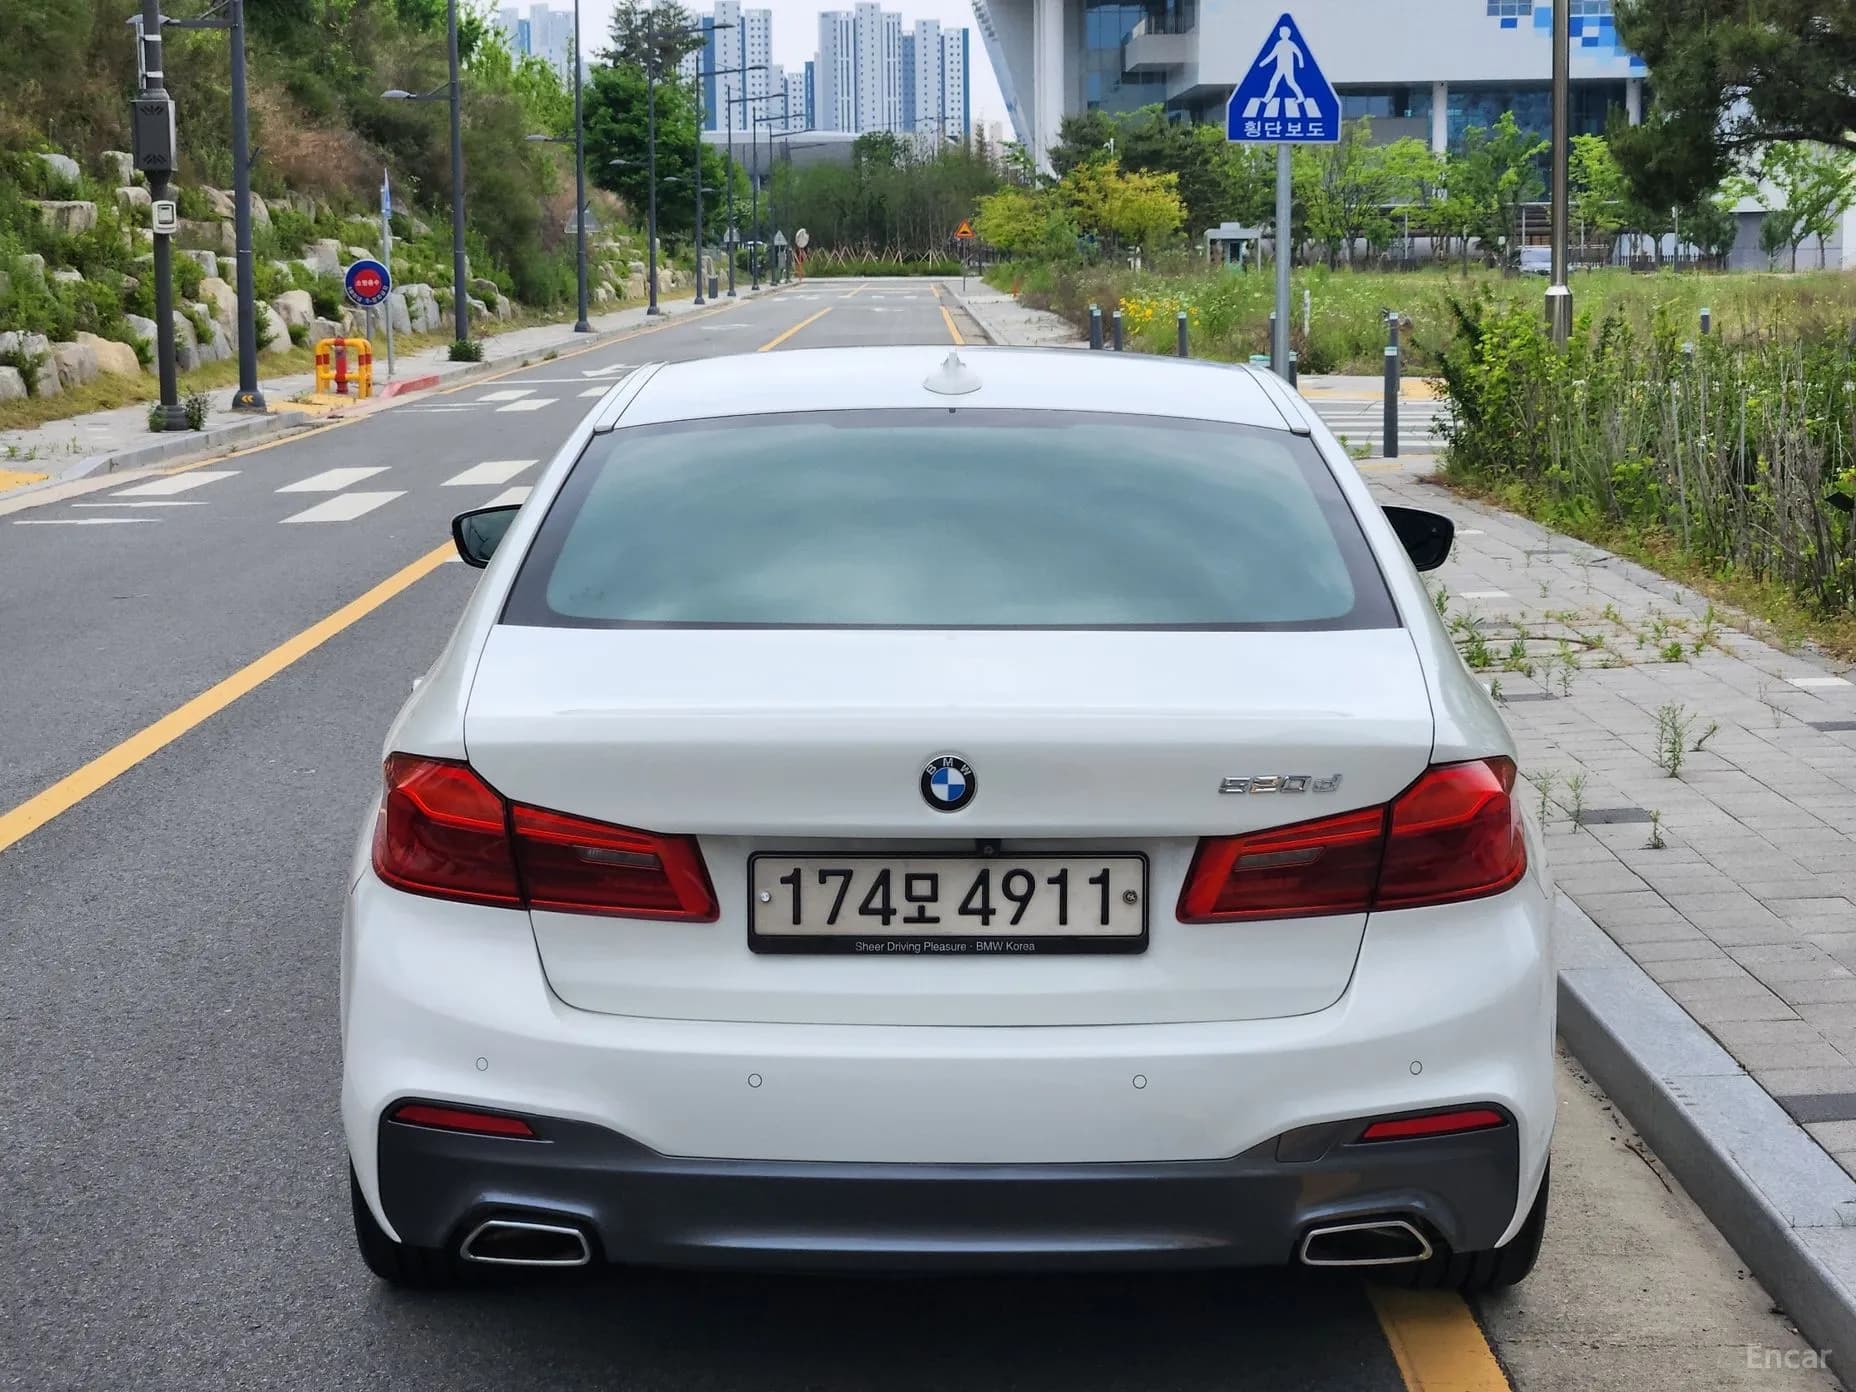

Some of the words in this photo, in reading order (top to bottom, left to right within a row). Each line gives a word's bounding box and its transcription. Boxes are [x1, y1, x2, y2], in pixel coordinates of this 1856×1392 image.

[1244, 120, 1325, 138] 횡단보도
[926, 757, 972, 776] BMW
[1218, 774, 1343, 793] 520d
[855, 942, 885, 951] Sheer
[887, 942, 921, 953] Driving
[923, 942, 967, 951] Pleasure
[976, 942, 1003, 951] BMW
[1006, 942, 1035, 951] Korea
